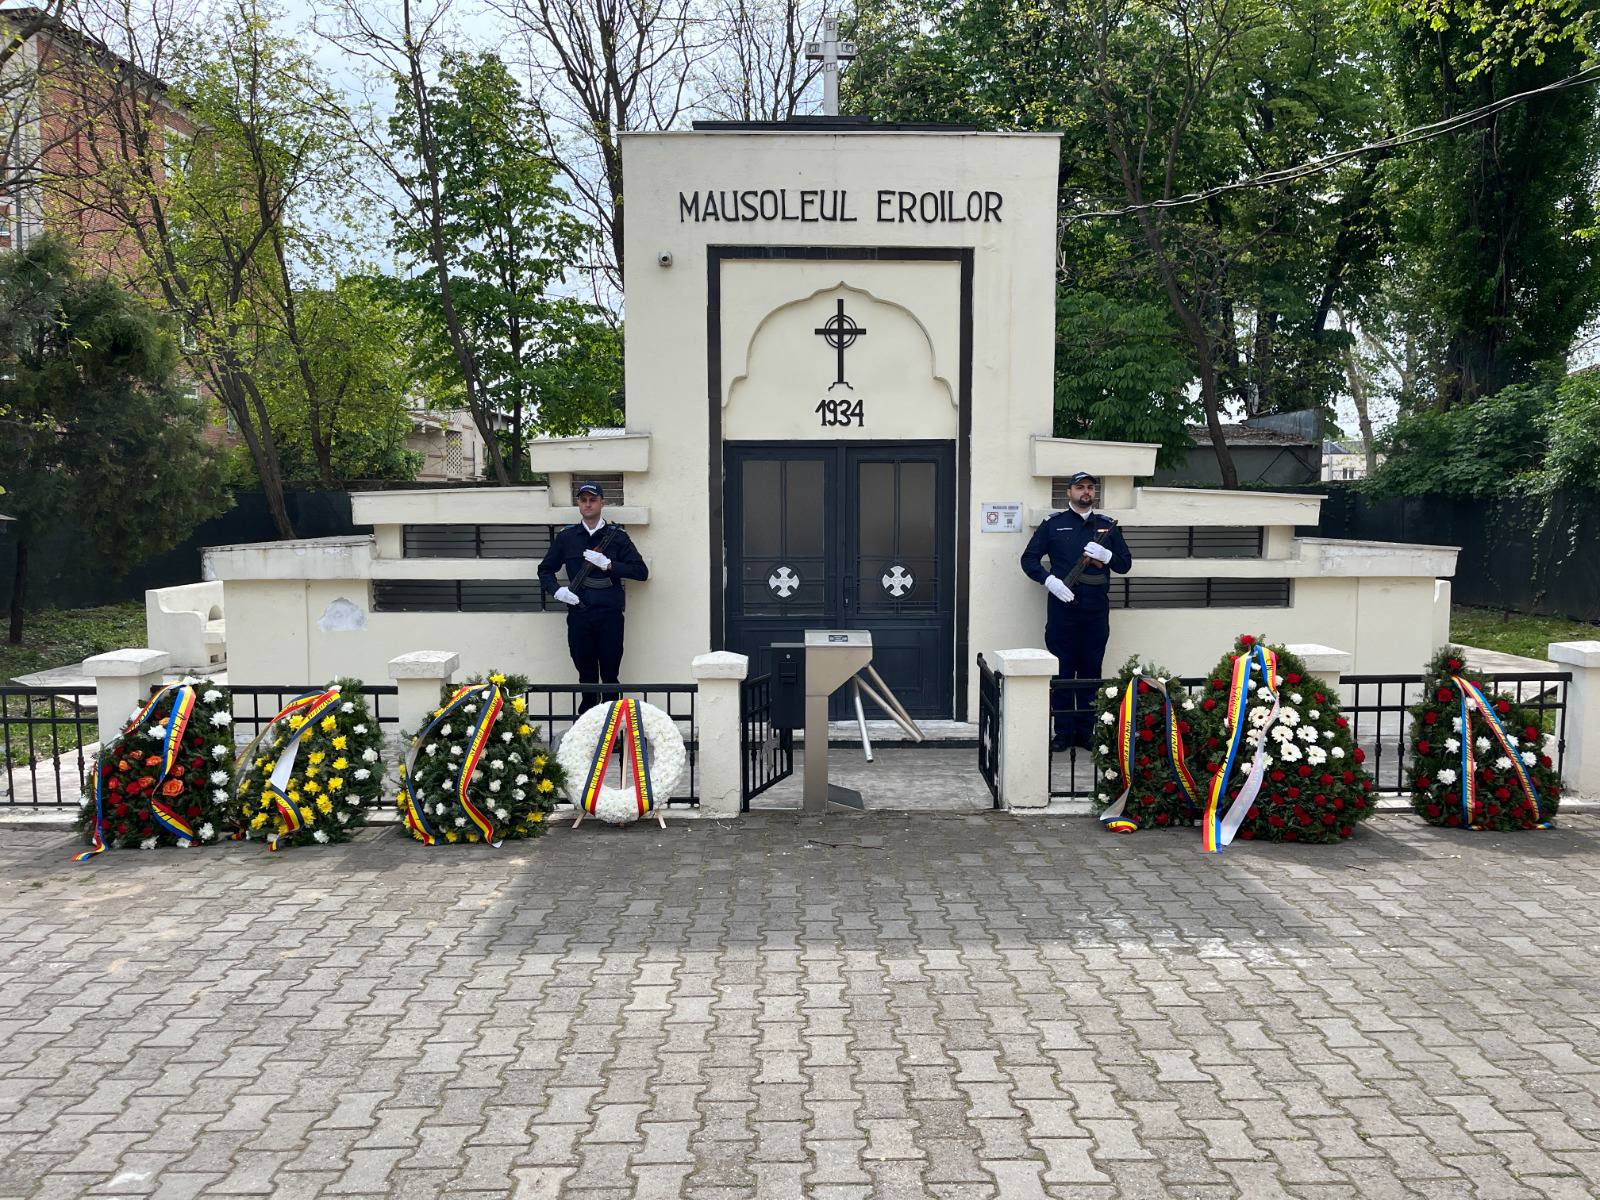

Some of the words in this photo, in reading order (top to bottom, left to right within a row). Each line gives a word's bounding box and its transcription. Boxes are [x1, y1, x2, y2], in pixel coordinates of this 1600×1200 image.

[679, 189, 857, 223] MAUSOLEUL
[876, 190, 1003, 223] EROILOR
[815, 399, 865, 427] 1934
